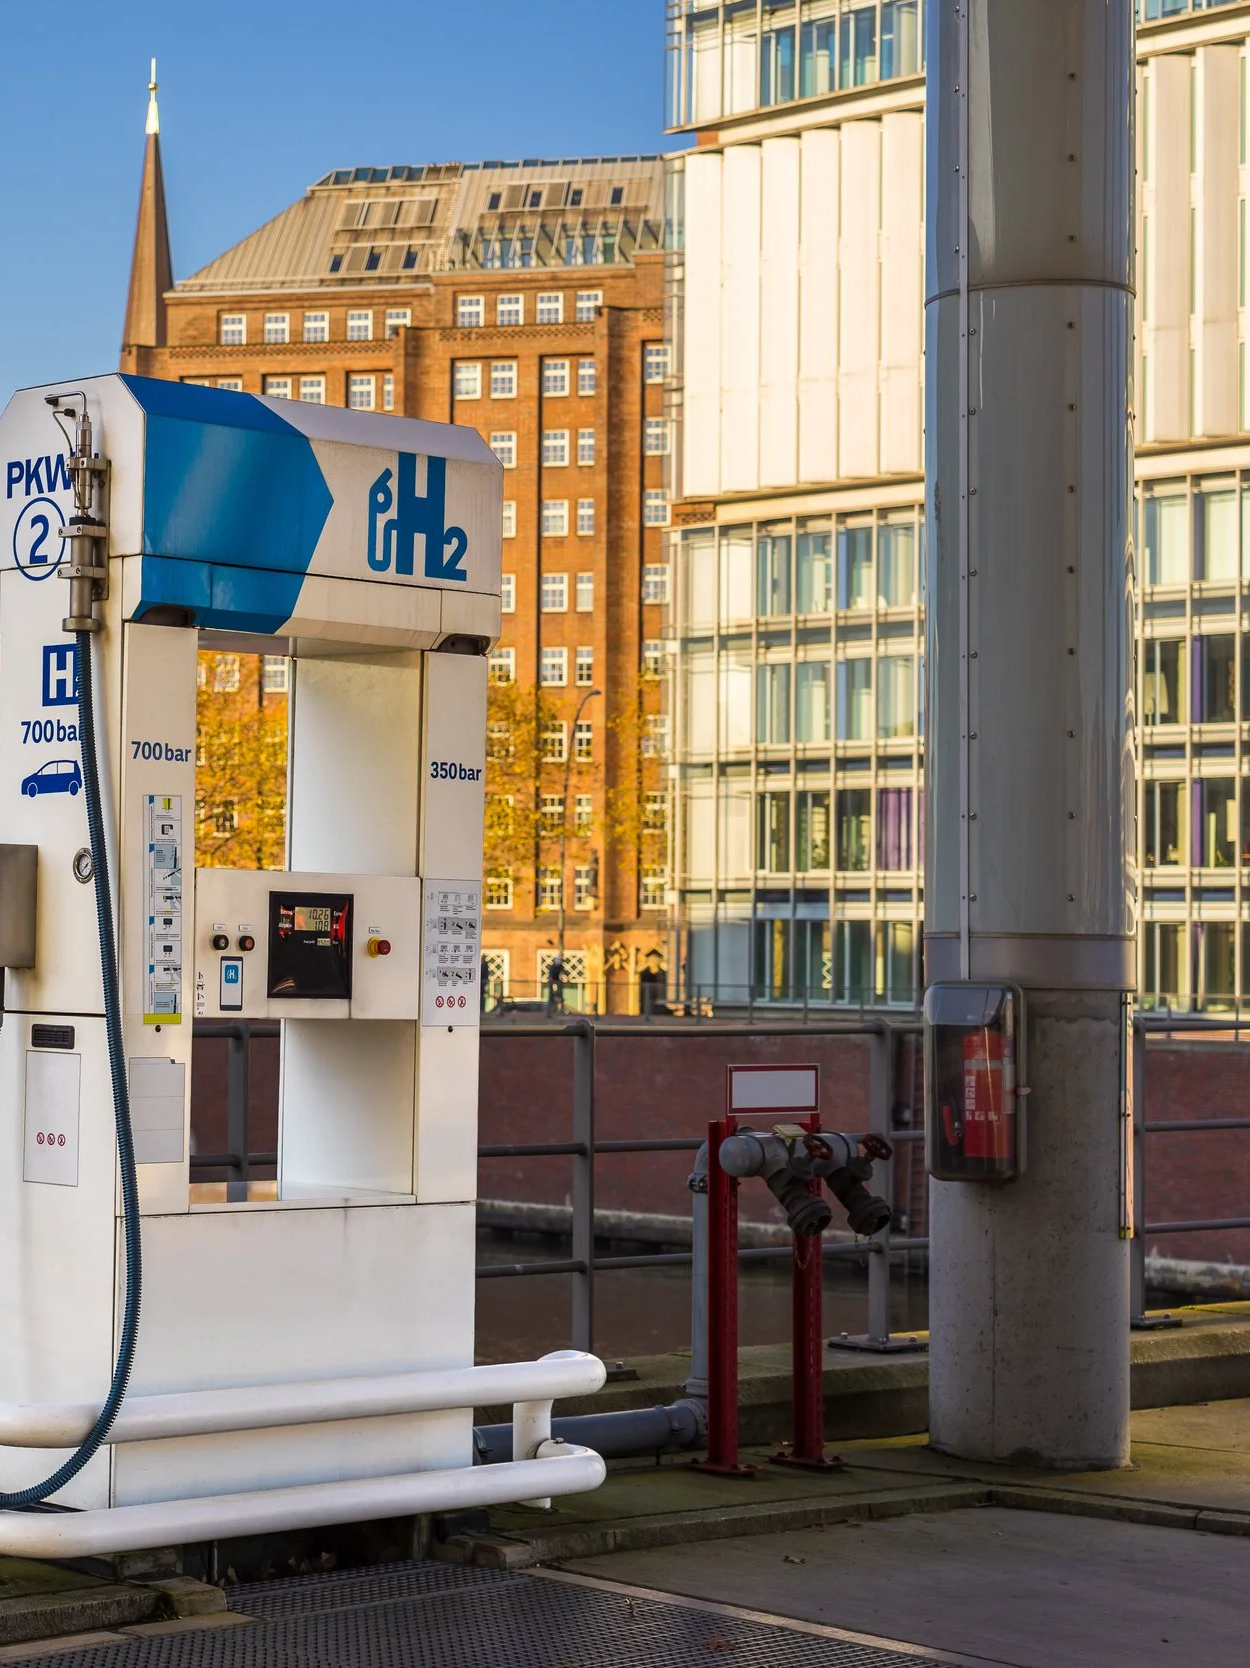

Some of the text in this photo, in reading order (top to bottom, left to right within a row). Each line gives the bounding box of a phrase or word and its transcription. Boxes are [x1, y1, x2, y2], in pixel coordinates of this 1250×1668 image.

[6, 453, 72, 500] PKW
[29, 514, 50, 565] 2
[49, 651, 79, 699] H
[21, 719, 81, 744] 700ba
